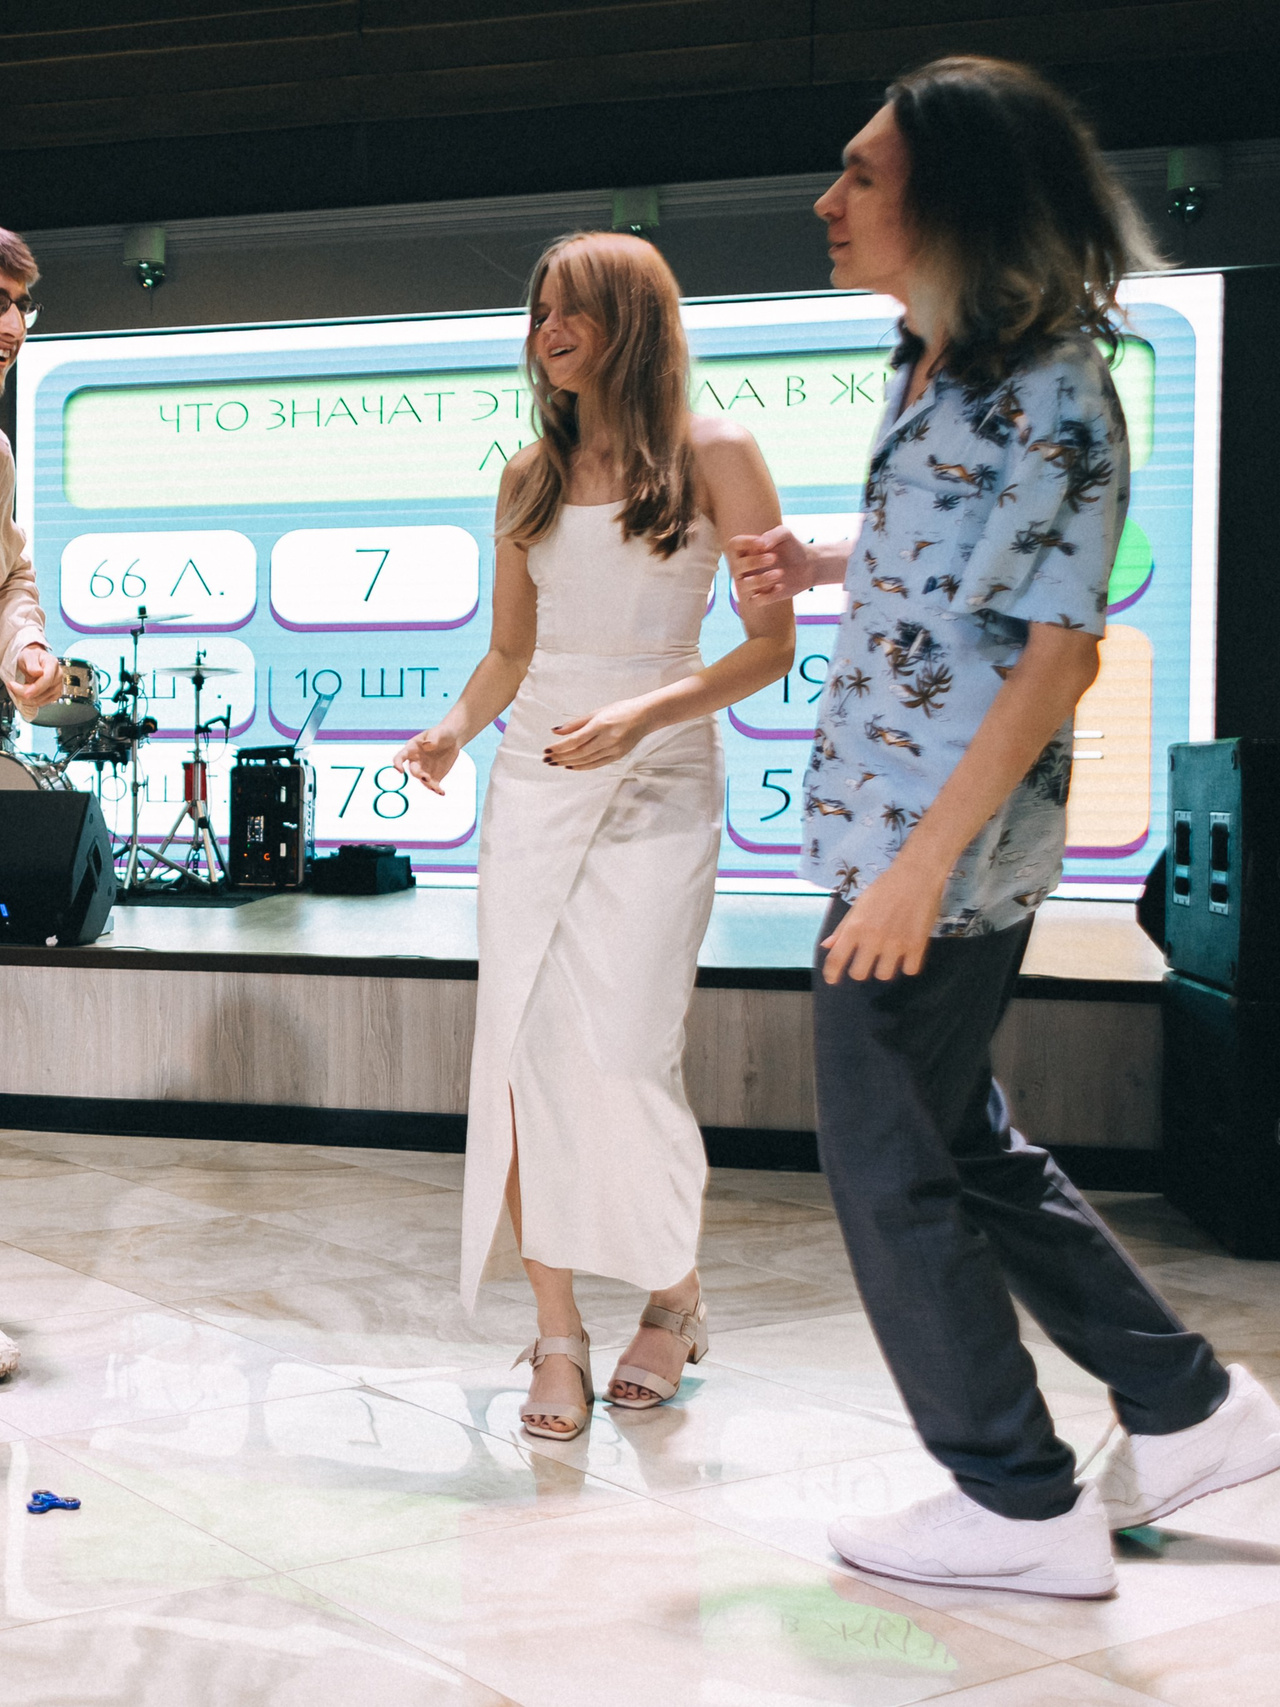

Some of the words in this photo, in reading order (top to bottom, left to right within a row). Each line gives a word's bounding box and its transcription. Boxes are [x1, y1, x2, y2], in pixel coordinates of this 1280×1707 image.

[158, 400, 250, 433] ЧТО
[266, 391, 457, 431] ЗНАЧАТ
[471, 387, 529, 421] ЭТ
[786, 375, 807, 407] В
[88, 557, 148, 599] 66
[355, 548, 391, 602] 7
[295, 667, 343, 697] 10
[361, 667, 449, 699] ШТ.
[330, 765, 410, 819] 78
